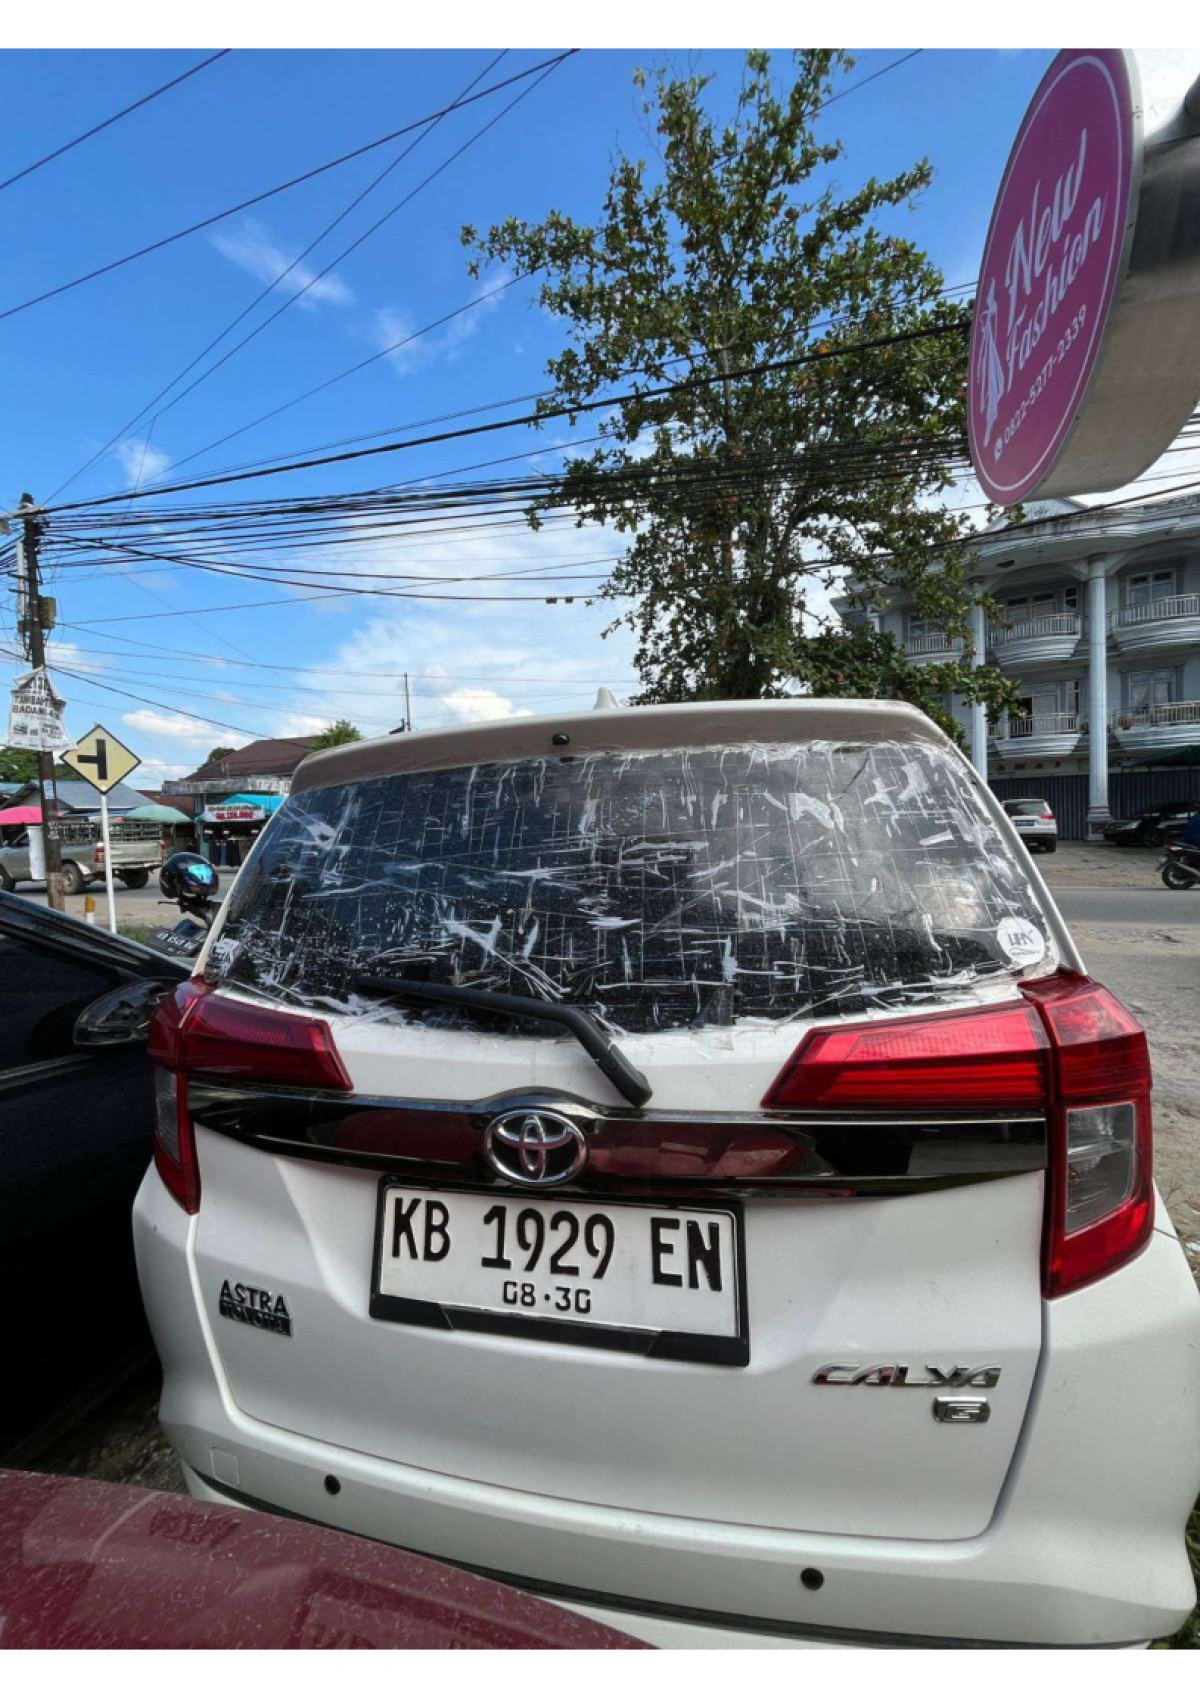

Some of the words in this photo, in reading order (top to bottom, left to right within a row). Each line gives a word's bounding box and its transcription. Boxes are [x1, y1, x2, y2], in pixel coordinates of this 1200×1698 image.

[1004, 127, 1088, 335] New
[1006, 189, 1110, 394] Fashion
[391, 1196, 451, 1263] KB
[480, 1205, 615, 1280] 1929
[650, 1216, 723, 1292] EN
[219, 1300, 292, 1336] TOYOTA
[220, 1279, 289, 1318] ASTRA
[811, 1362, 1002, 1388] CALYA
